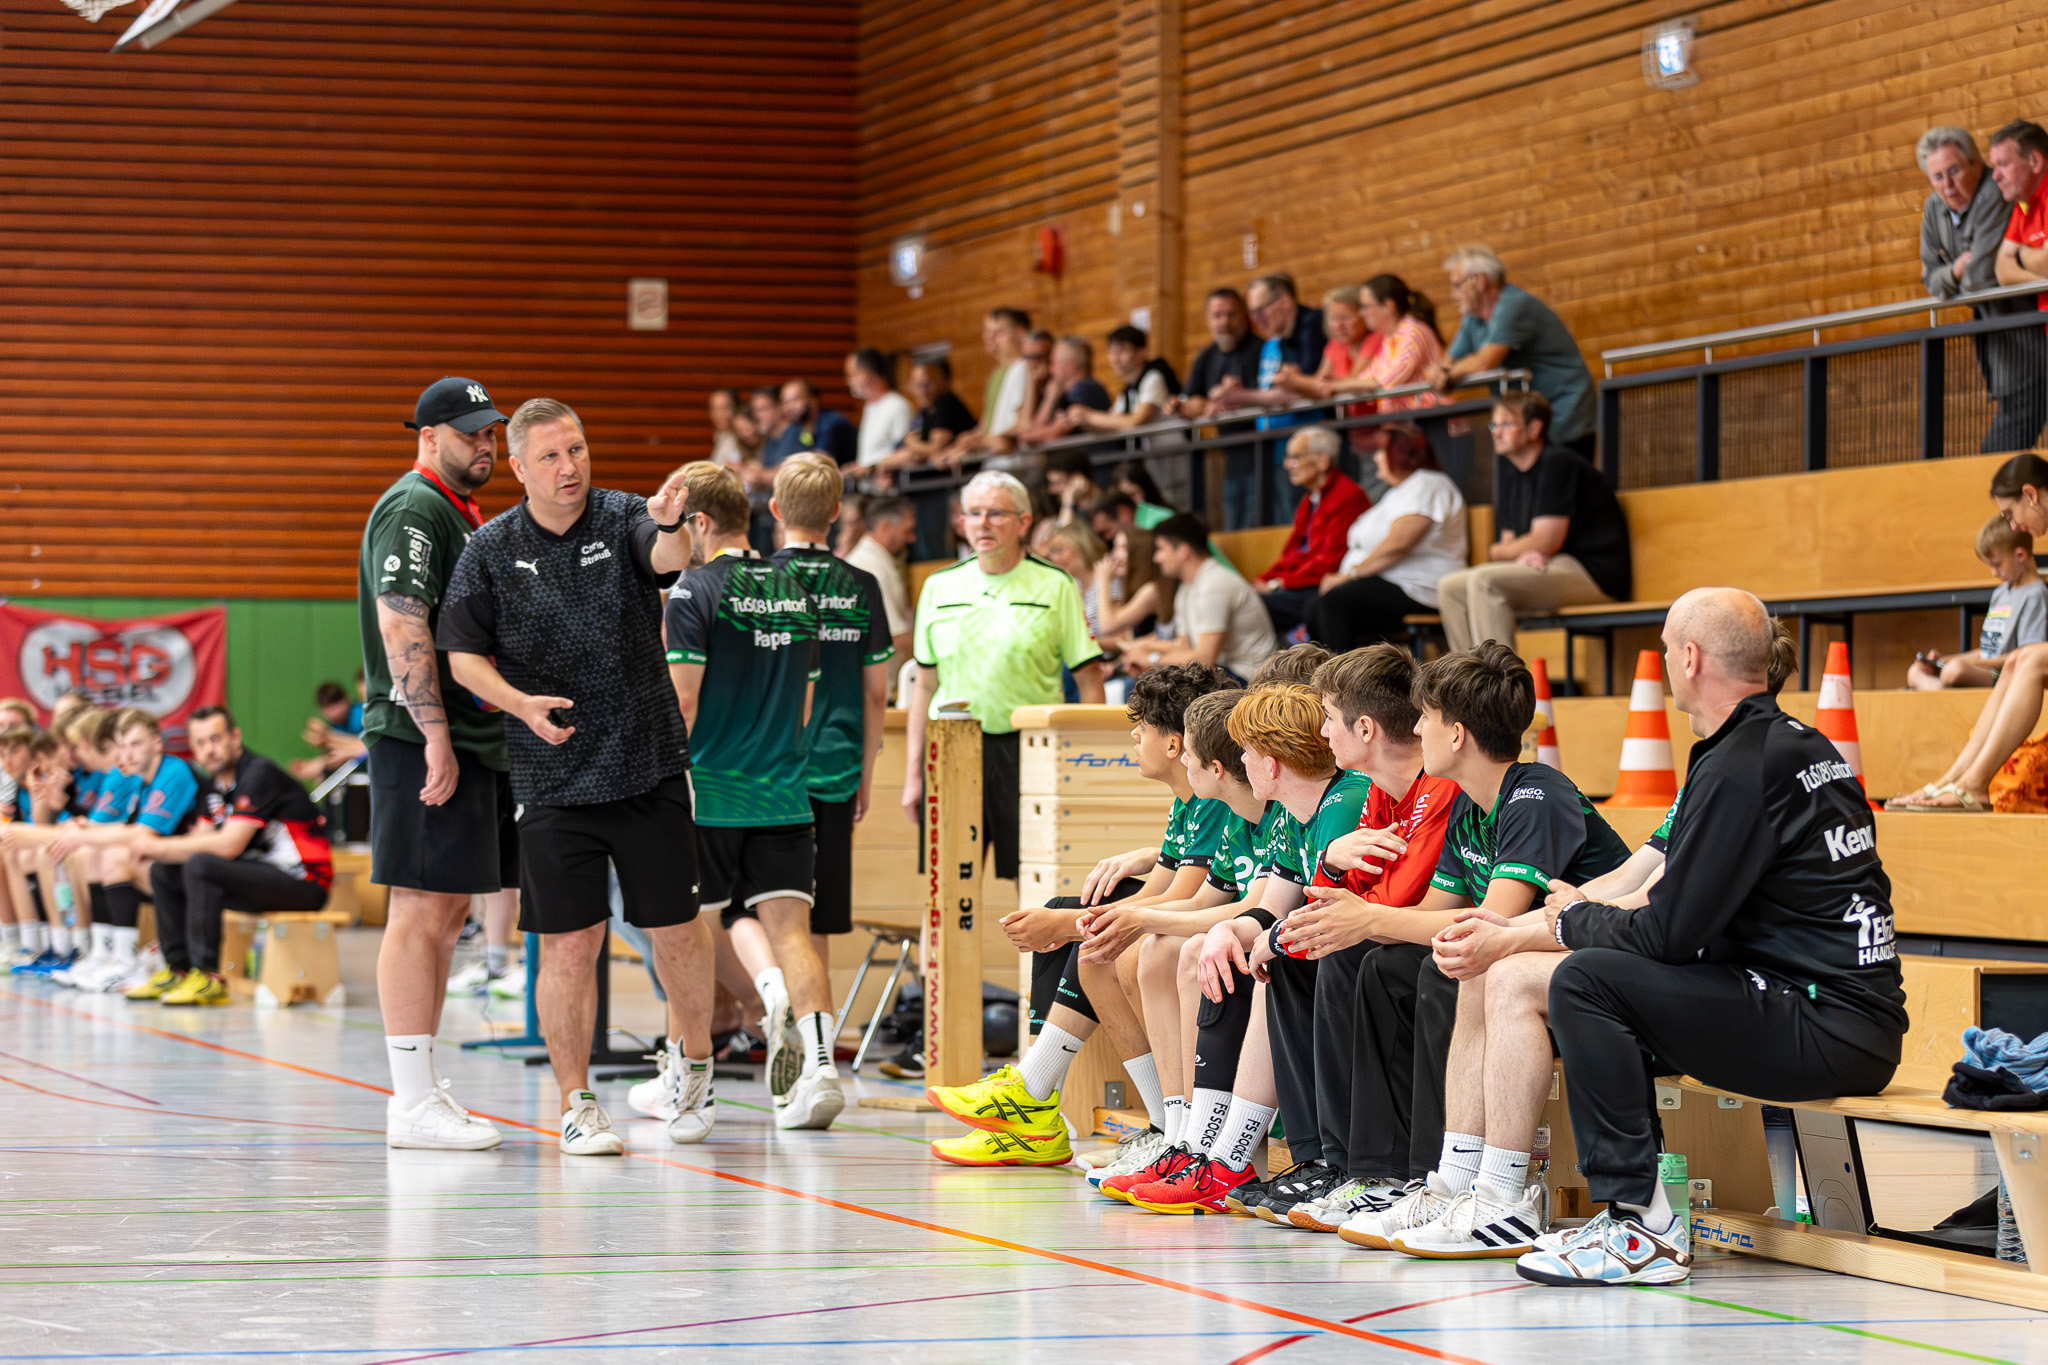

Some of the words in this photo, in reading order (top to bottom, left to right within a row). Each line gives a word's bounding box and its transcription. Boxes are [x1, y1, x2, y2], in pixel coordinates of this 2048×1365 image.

[466, 384, 489, 402] NY
[580, 540, 605, 555] Chris
[580, 548, 612, 567] Strauß
[754, 629, 791, 651] Pape
[42, 638, 172, 691] HSG
[1460, 846, 1488, 865] Kempa
[1499, 864, 1527, 875] Kempa
[1432, 873, 1455, 887] Kempa
[1215, 1102, 1229, 1116] FS
[1200, 1115, 1222, 1149] SOCKS
[1245, 1118, 1260, 1132] FS
[1230, 1132, 1253, 1163] SOCKS
